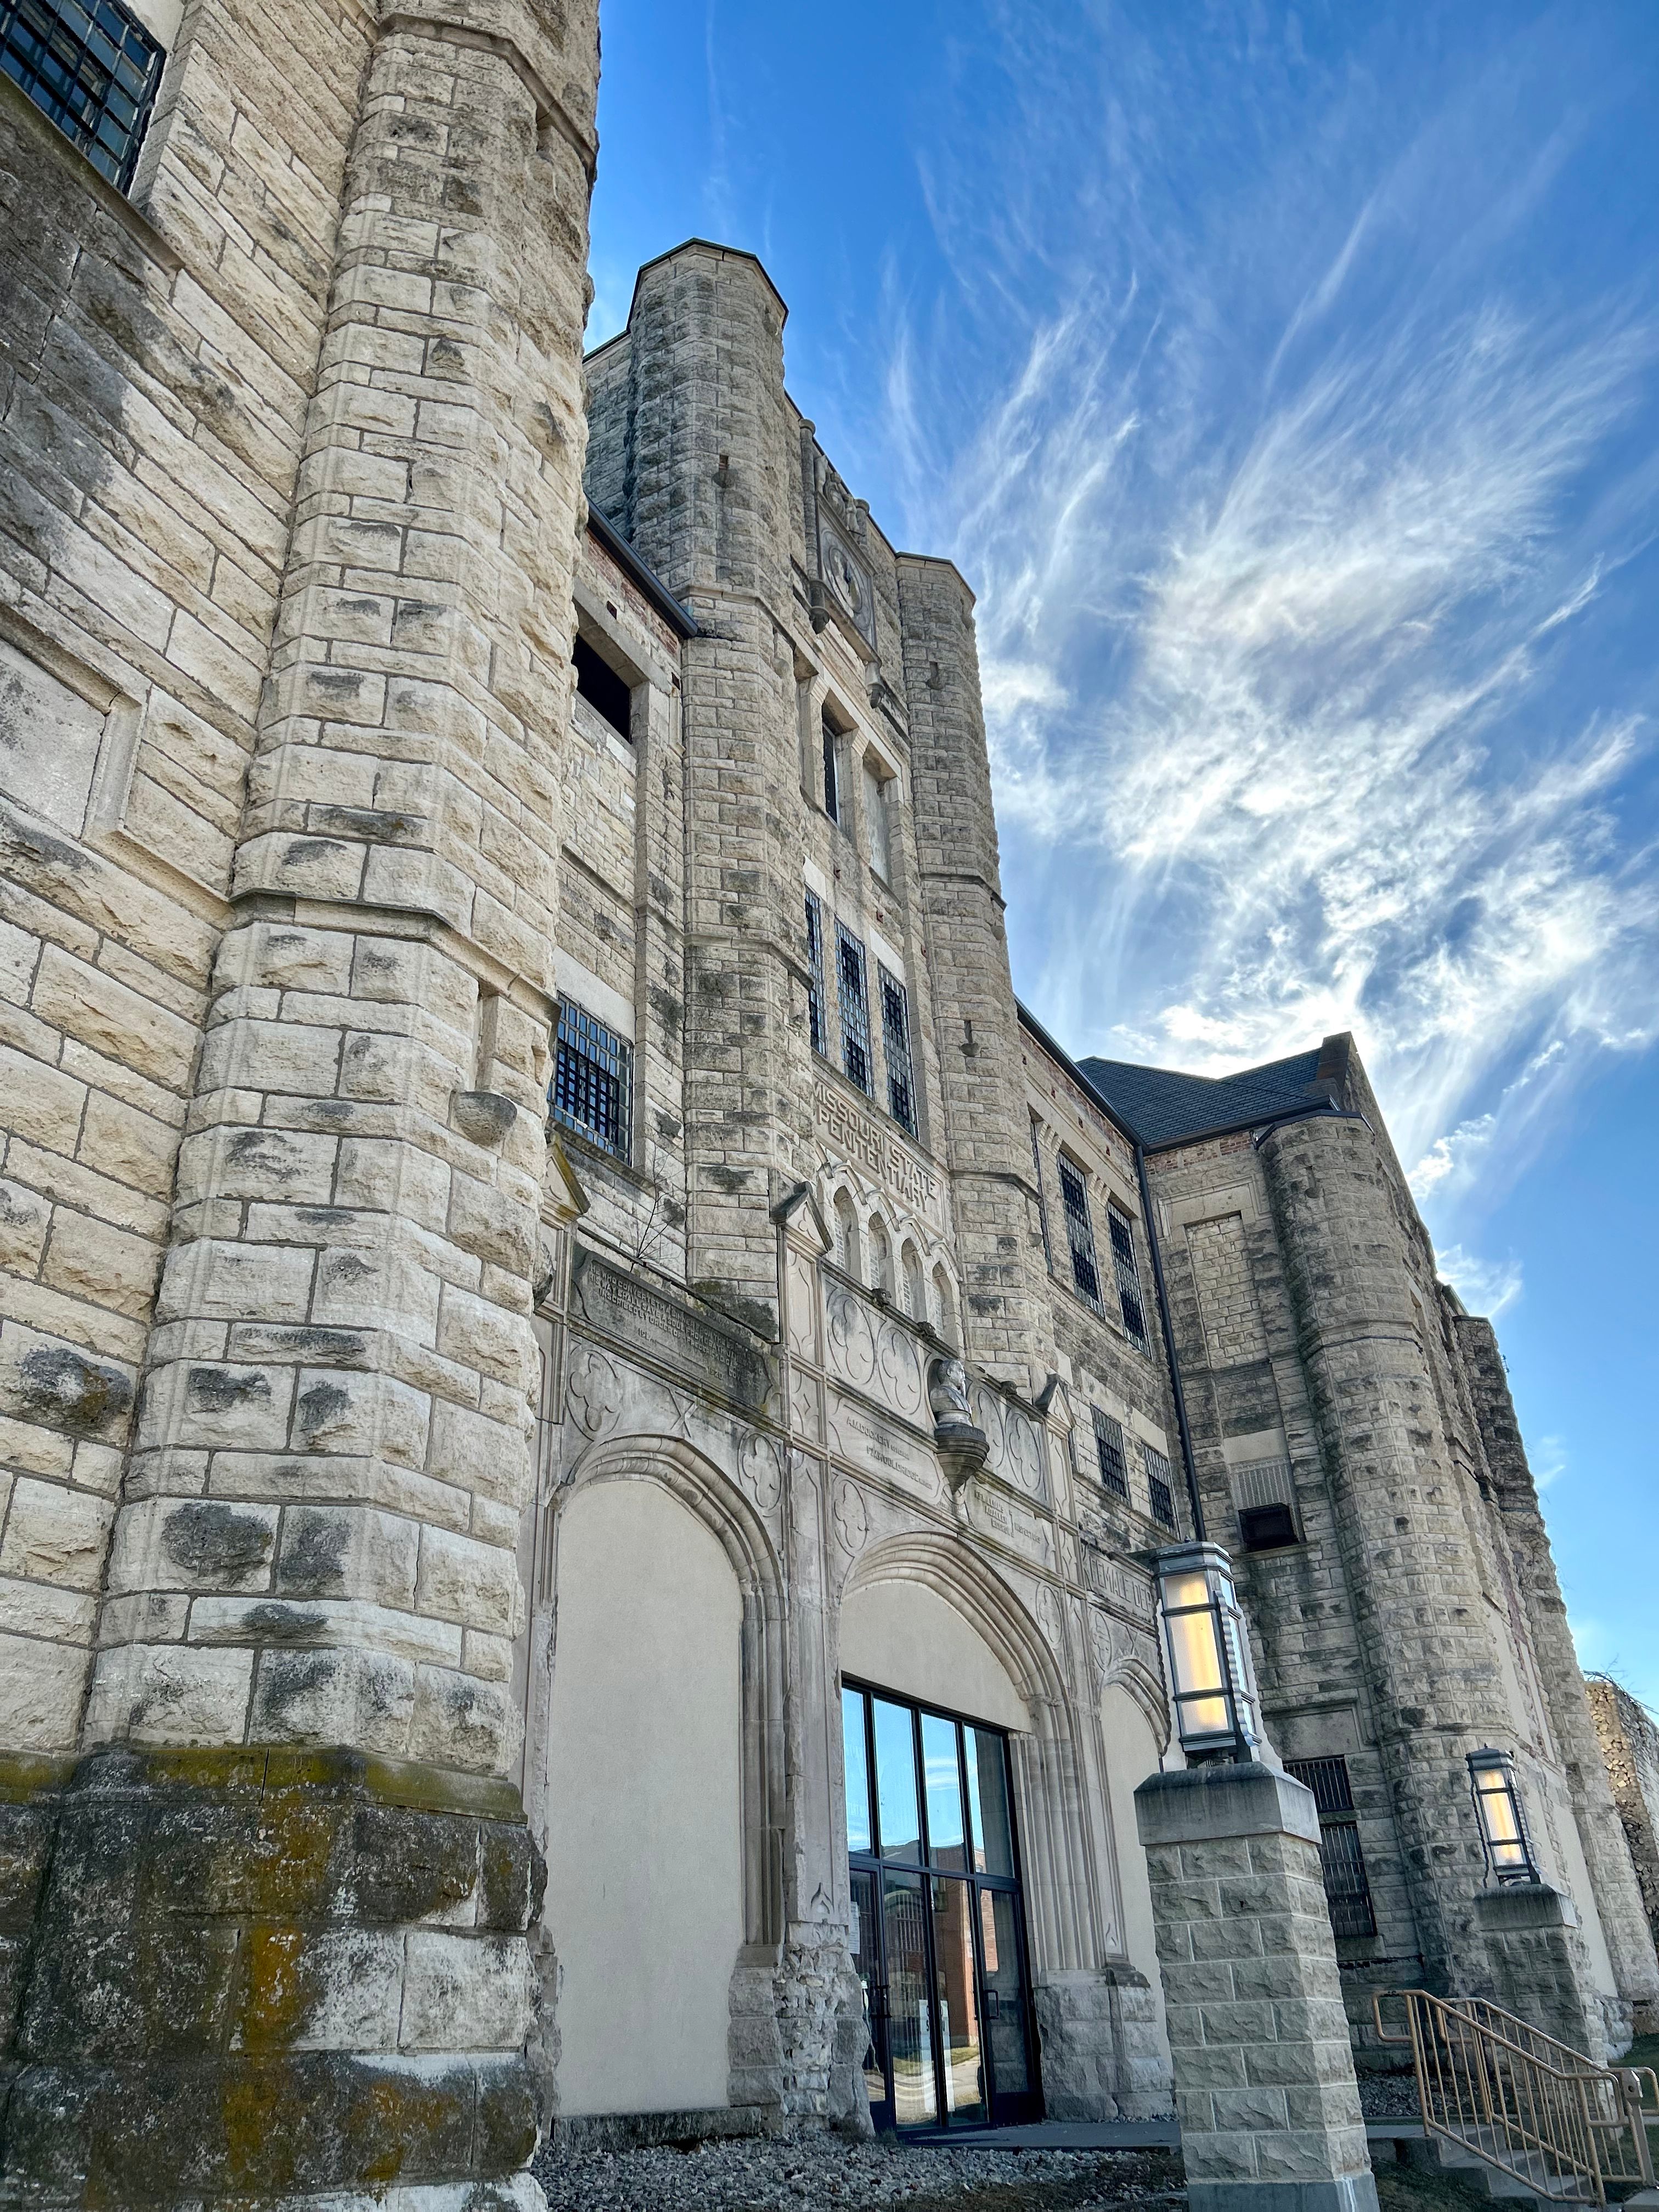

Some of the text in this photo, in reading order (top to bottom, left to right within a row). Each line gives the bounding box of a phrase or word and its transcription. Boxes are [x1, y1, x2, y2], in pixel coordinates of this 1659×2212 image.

[814, 1081, 936, 1200] MISSOURI STATE
[817, 1104, 927, 1212] PENITENTIARY
[589, 1273, 600, 1285] HIS
[601, 1279, 616, 1293] WAY
[618, 1288, 641, 1307] SHALL
[641, 1302, 660, 1317] SAVE
[668, 1318, 685, 1333] SOUL
[686, 1327, 703, 1342] FROM
[704, 1338, 724, 1354] DEATH
[590, 1262, 600, 1276] HE
[602, 1271, 616, 1284] WHO
[618, 1280, 664, 1311] CONVERTETH
[671, 1306, 695, 1328] SINNER
[599, 1288, 637, 1316] INSCRIBED
[639, 1309, 648, 1321] BY
[650, 1317, 672, 1334] ORDER
[673, 1329, 680, 1338] OF
[1090, 1556, 1153, 1612] FEMALE DEP
